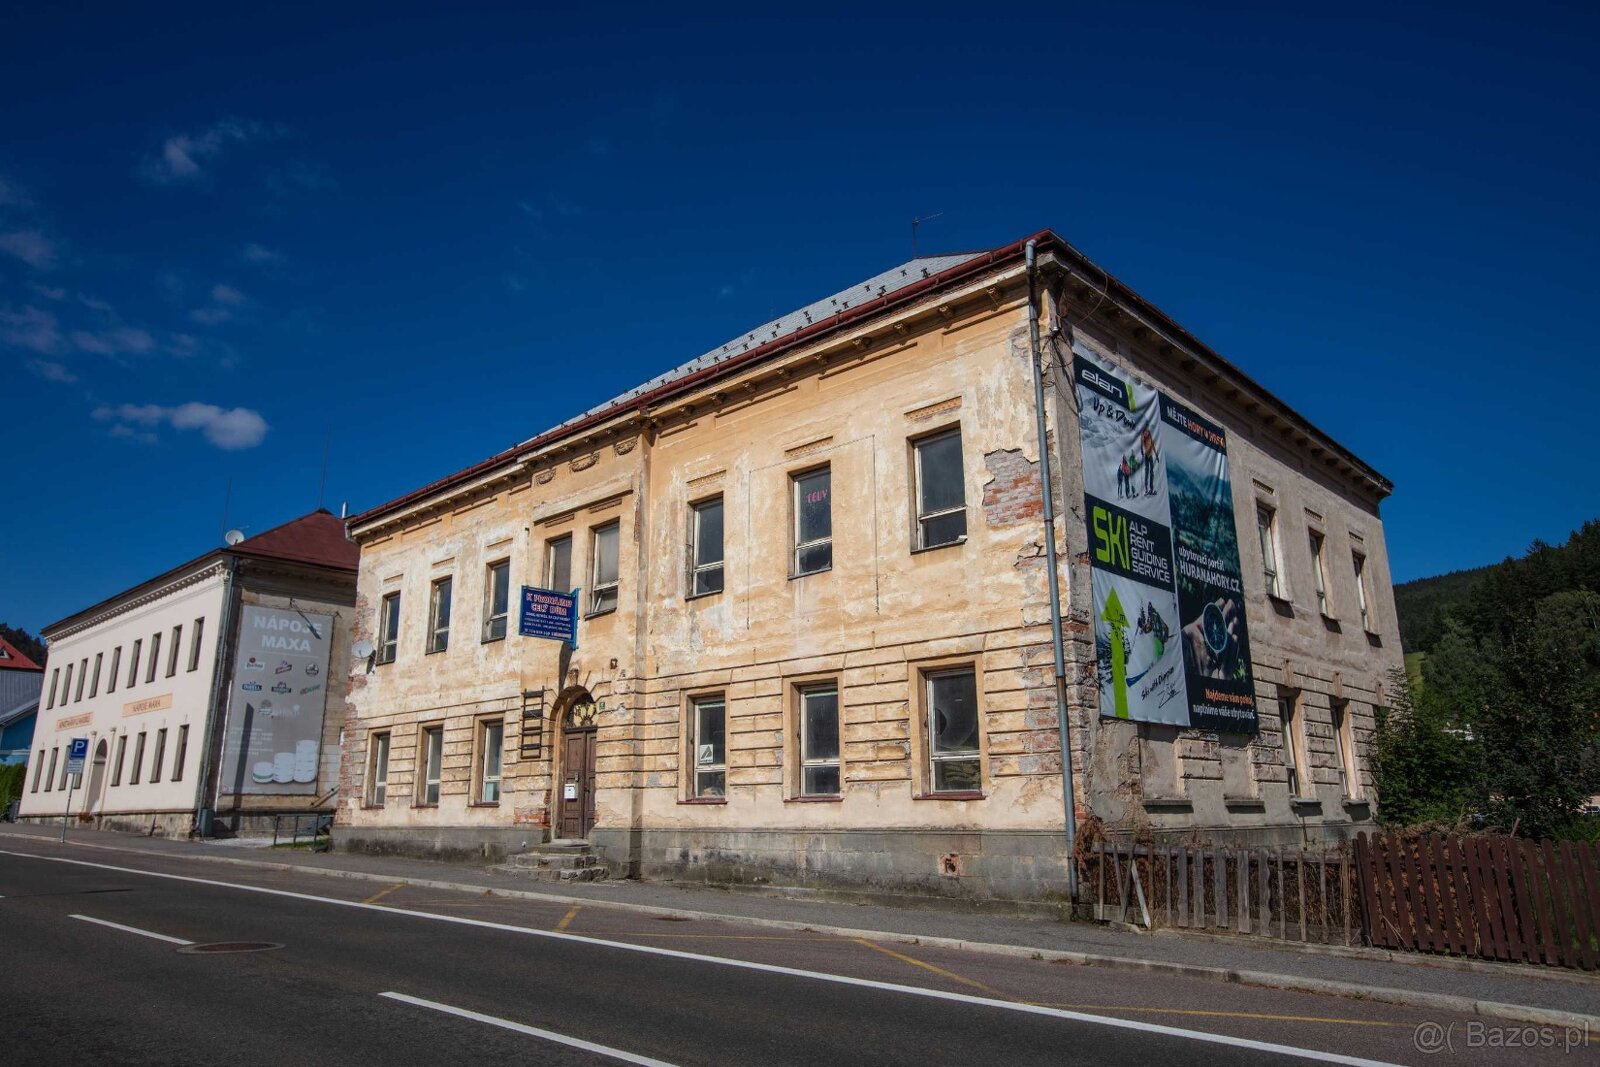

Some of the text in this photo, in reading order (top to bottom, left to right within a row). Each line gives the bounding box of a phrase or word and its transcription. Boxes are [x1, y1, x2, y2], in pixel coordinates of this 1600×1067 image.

[1081, 369, 1123, 399] elan
[1093, 396, 1105, 416] Up
[1107, 405, 1114, 419] &
[1093, 505, 1131, 571] SKI
[1129, 520, 1148, 536] ALP
[1129, 533, 1155, 553] RENT
[1131, 547, 1168, 570] GUIDING
[1131, 560, 1171, 584] SERVICE
[1179, 560, 1241, 593] HURANAHORY.CZ
[253, 614, 323, 636] NÁPOJE
[261, 635, 312, 653] MAXA
[73, 740, 85, 753] P
